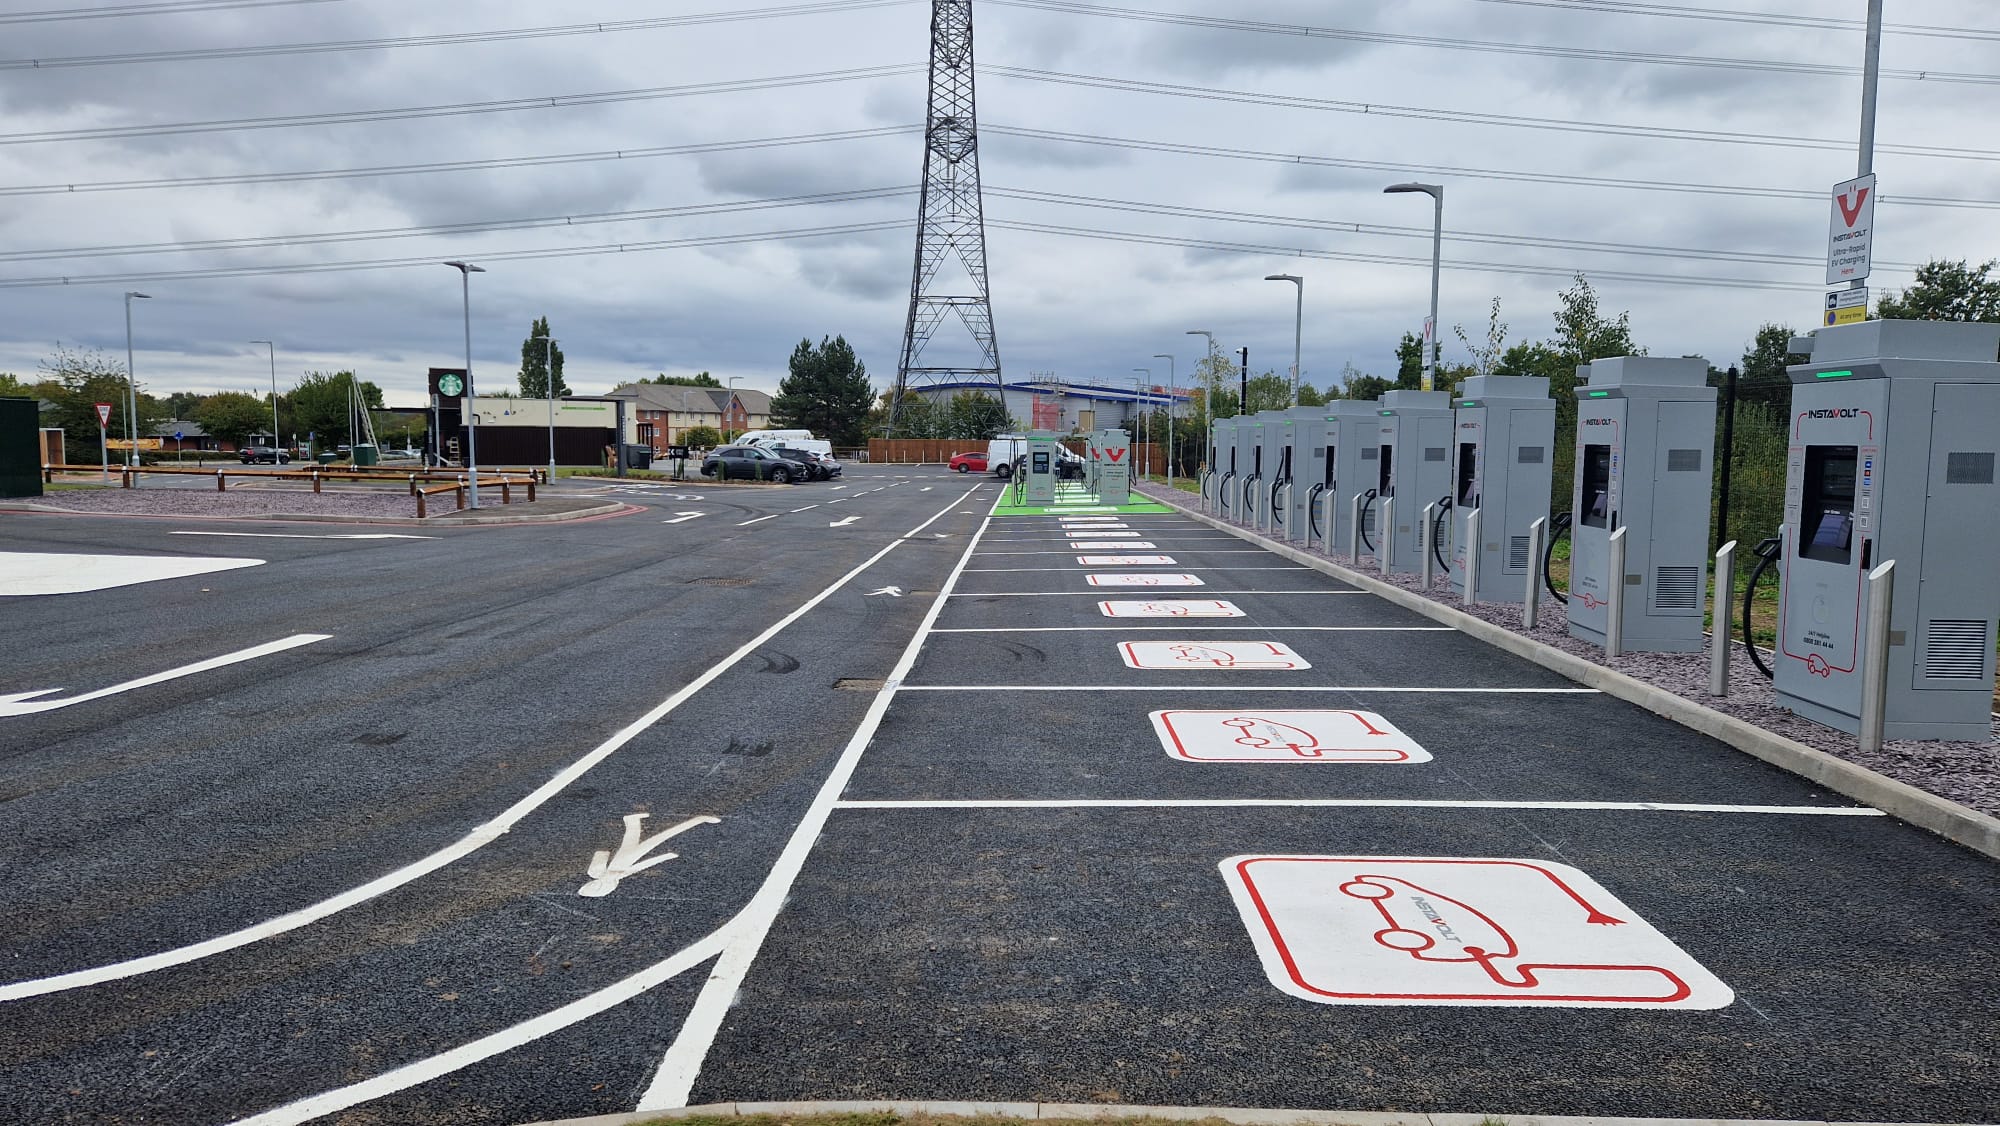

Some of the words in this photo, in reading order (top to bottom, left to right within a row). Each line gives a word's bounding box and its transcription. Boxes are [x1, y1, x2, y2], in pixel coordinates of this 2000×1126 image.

[1833, 229, 1867, 242] INSTAVOLT
[1839, 255, 1866, 266] Charging
[1808, 408, 1859, 419] INSTAVOLT
[1586, 418, 1612, 426] INSTAVOLT
[1410, 896, 1463, 943] INSTAVOLT
